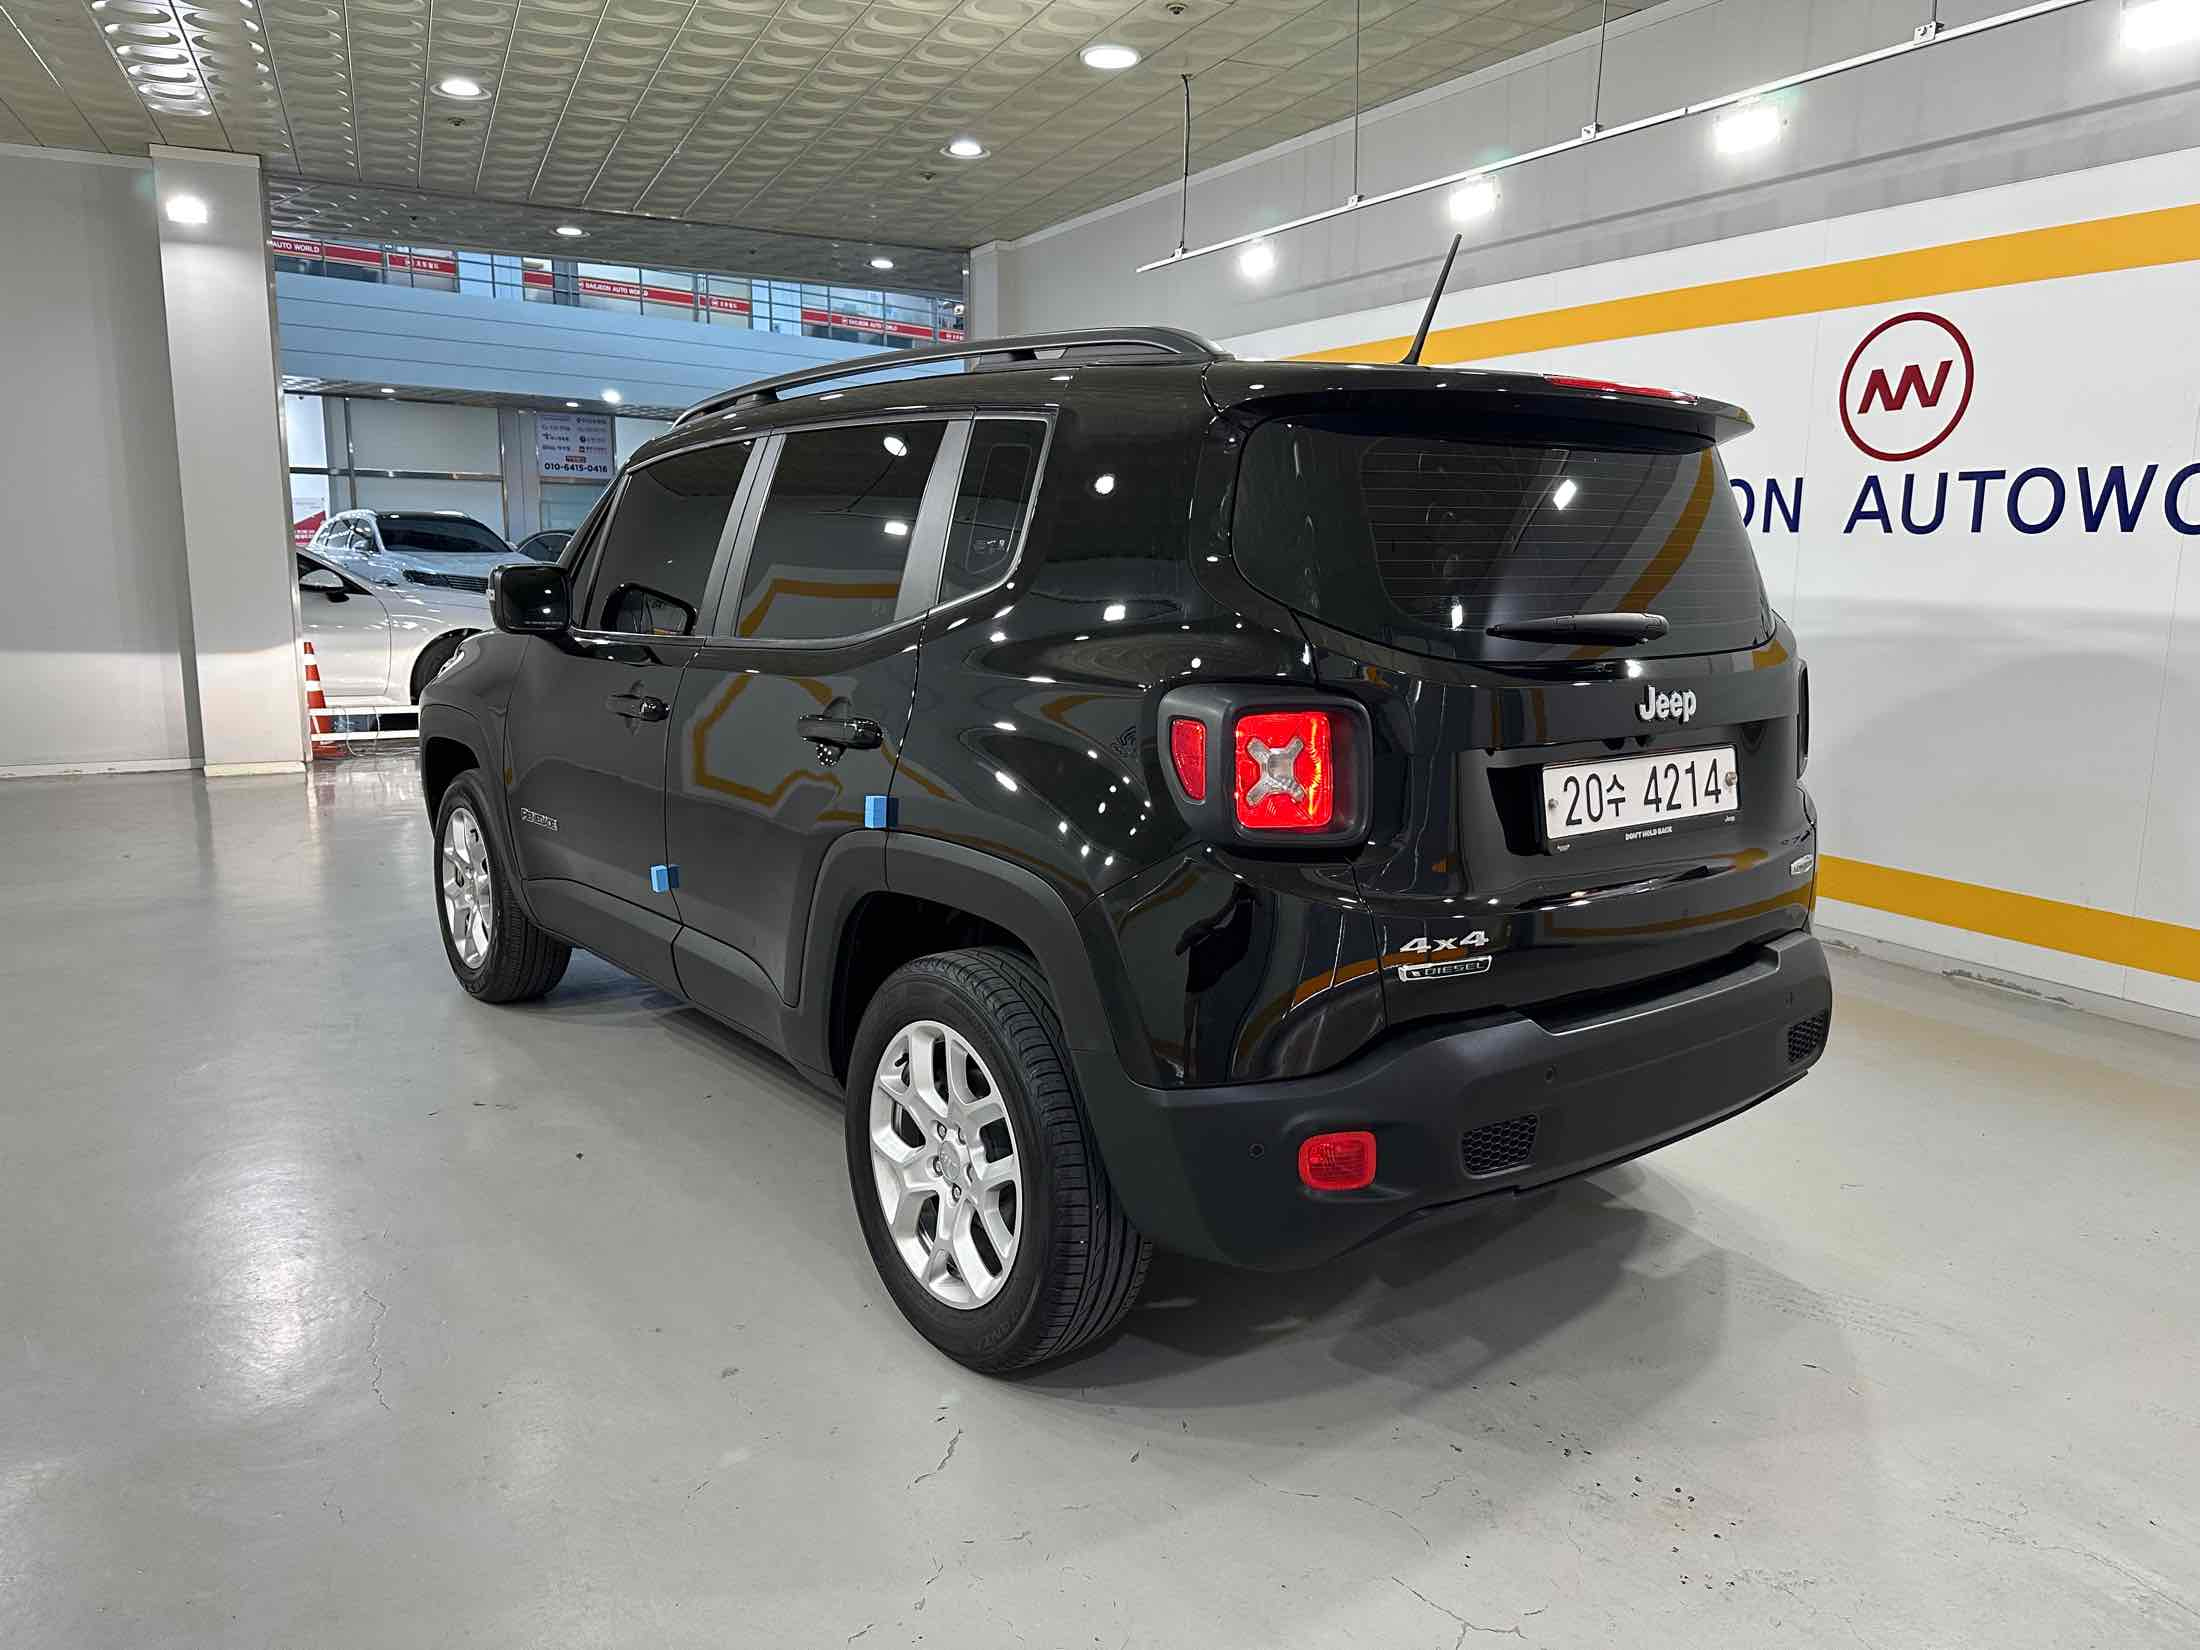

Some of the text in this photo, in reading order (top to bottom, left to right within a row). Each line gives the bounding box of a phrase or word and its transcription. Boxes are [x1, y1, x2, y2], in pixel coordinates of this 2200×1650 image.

[1639, 685, 1697, 723] Jeep
[1563, 758, 1722, 826] 20수 4214
[1657, 826, 1673, 834] BACK
[1424, 962, 1486, 976] DIESEL
